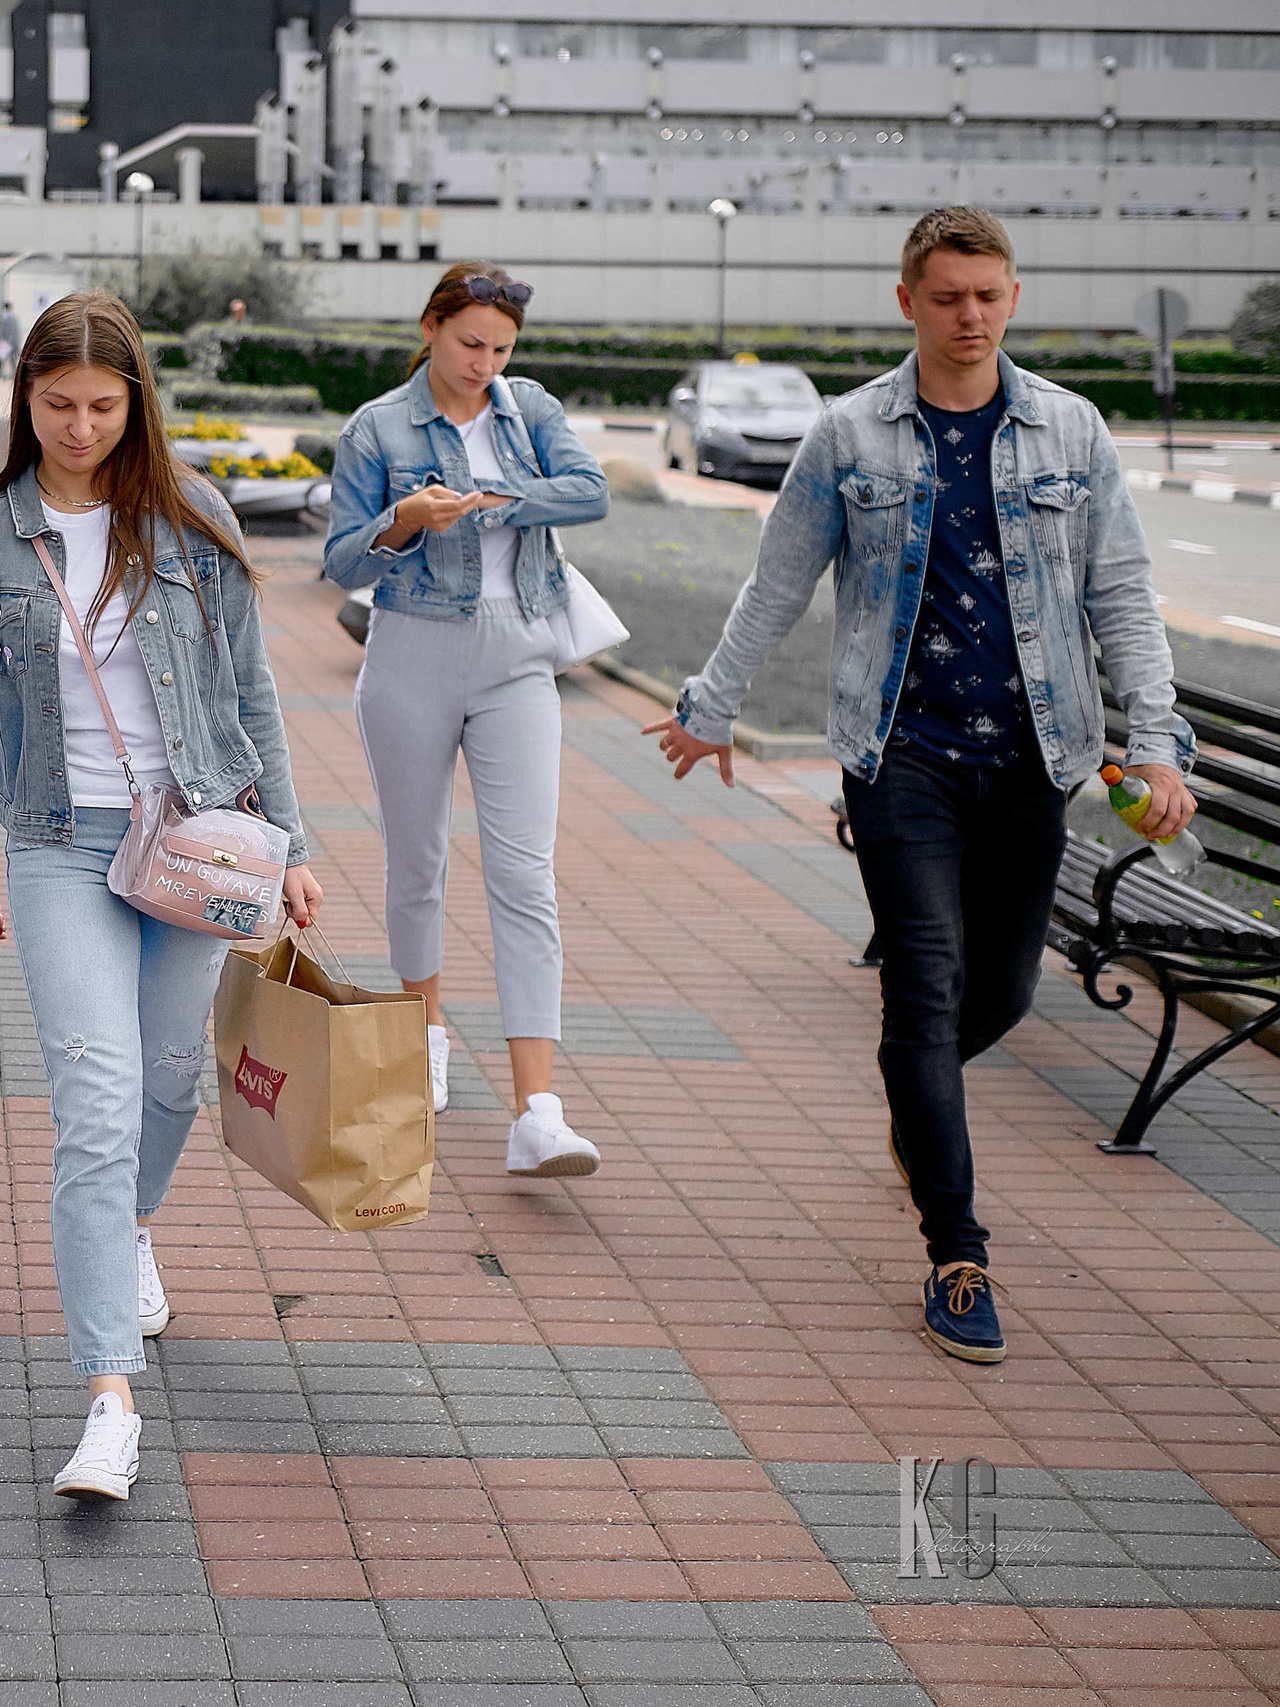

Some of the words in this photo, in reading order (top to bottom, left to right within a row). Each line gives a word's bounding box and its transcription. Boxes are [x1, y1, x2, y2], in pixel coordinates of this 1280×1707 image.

[165, 852, 194, 873] UN
[197, 864, 272, 904] GOYAVE
[237, 1061, 273, 1100] LVI'S
[355, 1203, 406, 1217] Levi.com
